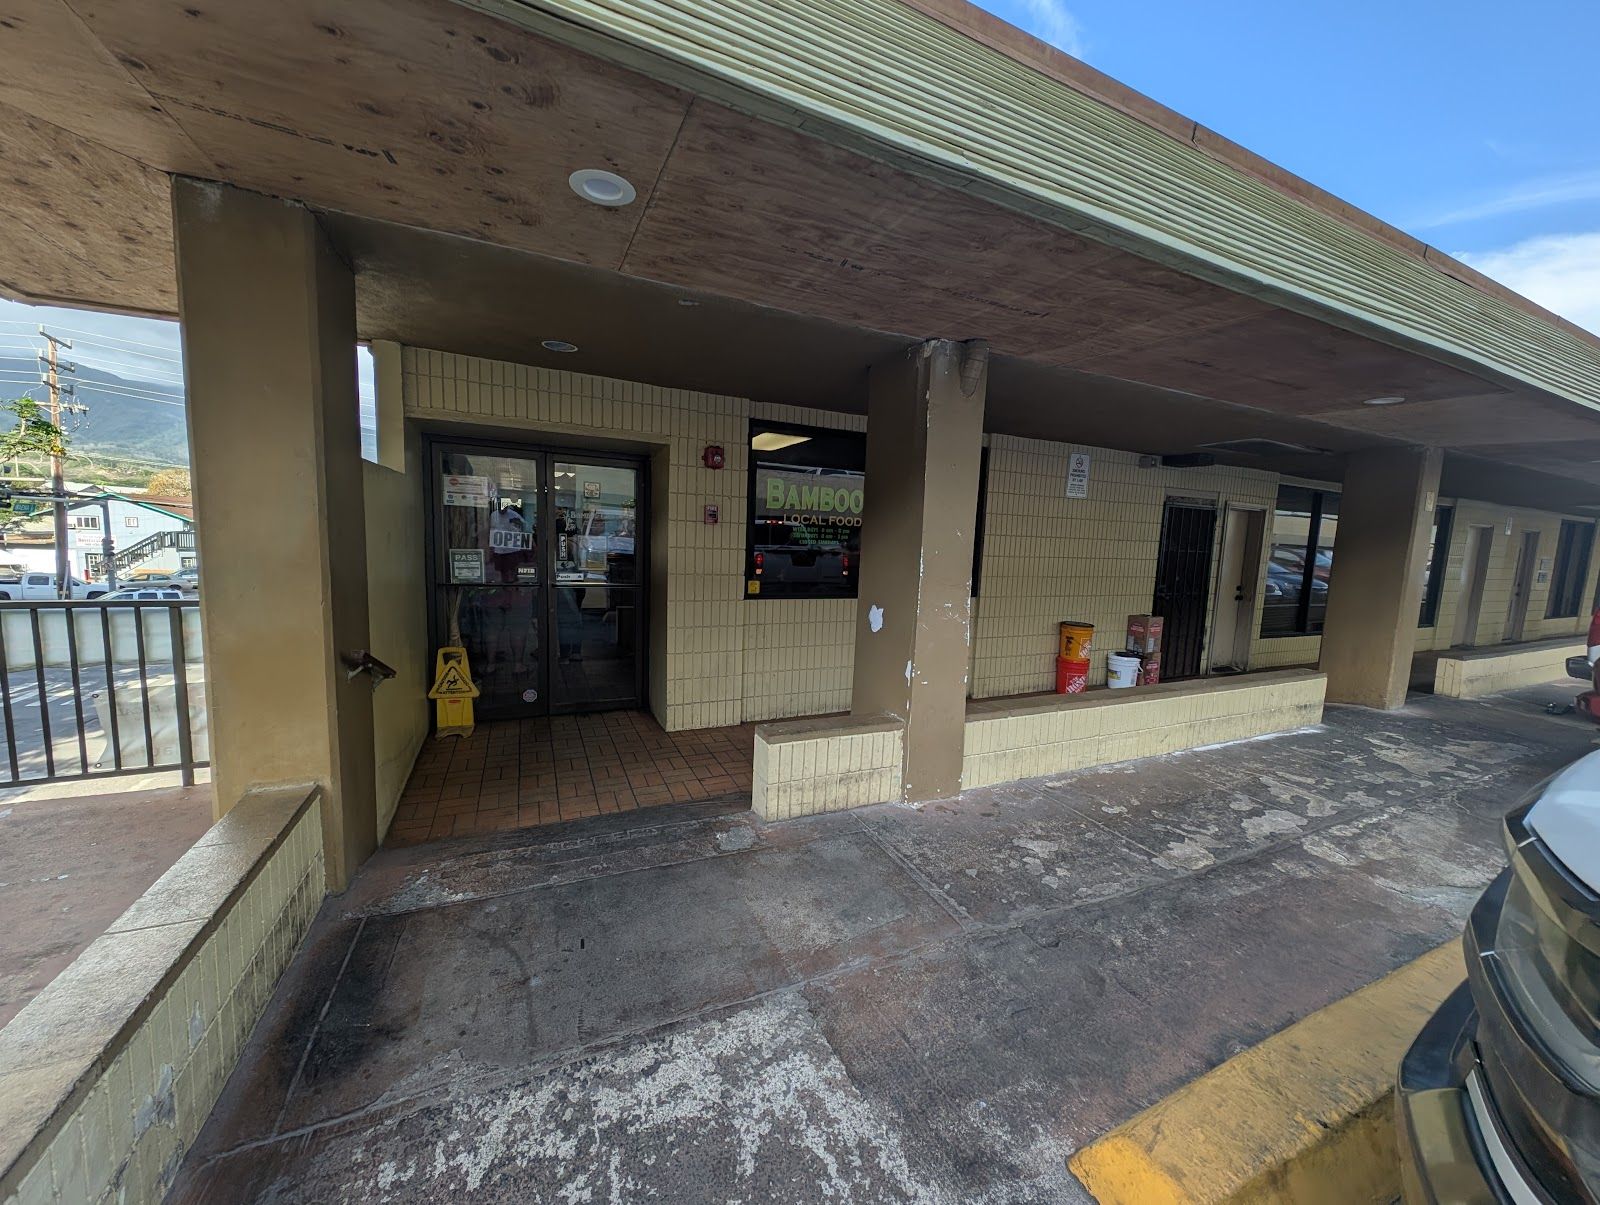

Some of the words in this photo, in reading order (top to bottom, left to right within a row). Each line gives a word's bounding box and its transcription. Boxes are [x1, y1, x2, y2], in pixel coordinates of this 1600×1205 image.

[766, 478, 864, 514] BAMBOO
[784, 514, 827, 526] LOCAL
[829, 516, 863, 527] FOOD
[494, 531, 531, 549] OPEN
